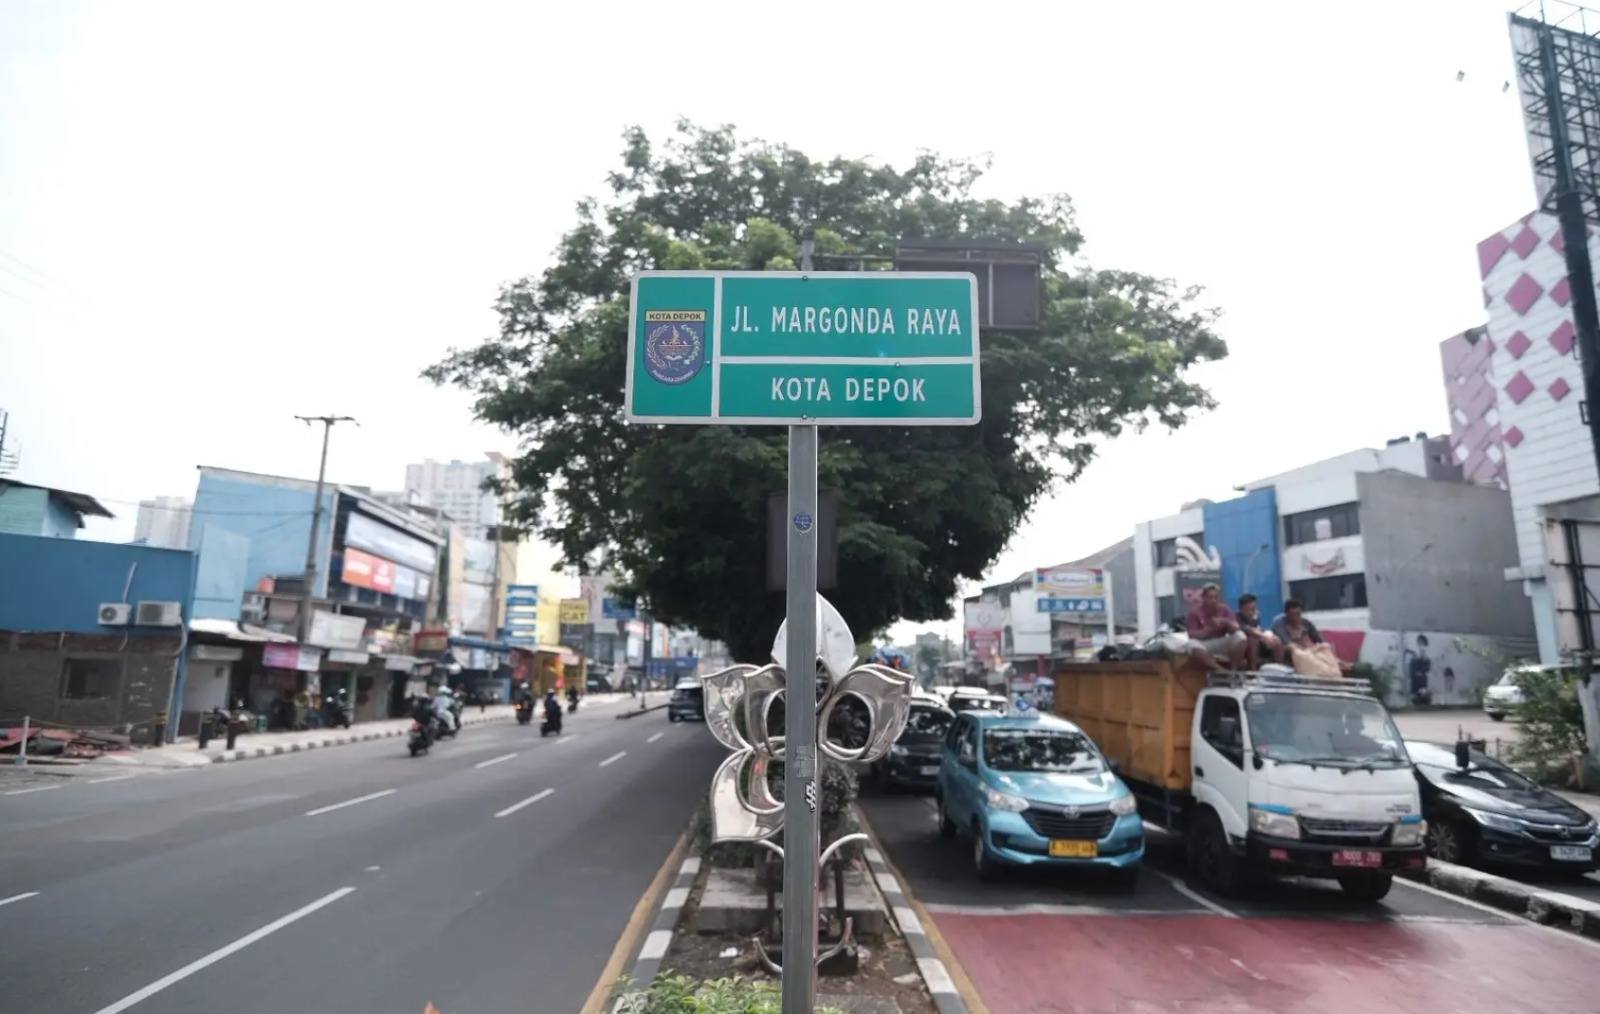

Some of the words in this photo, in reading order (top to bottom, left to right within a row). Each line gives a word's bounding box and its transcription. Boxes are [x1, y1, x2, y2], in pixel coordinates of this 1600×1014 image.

[649, 312, 671, 320] KOTA
[673, 312, 701, 320] DEPOK
[731, 305, 759, 333] JL.
[771, 306, 896, 334] MARGONDA
[907, 308, 962, 335] RAYA
[771, 377, 832, 402] KOTA
[845, 378, 927, 402] DEPOK
